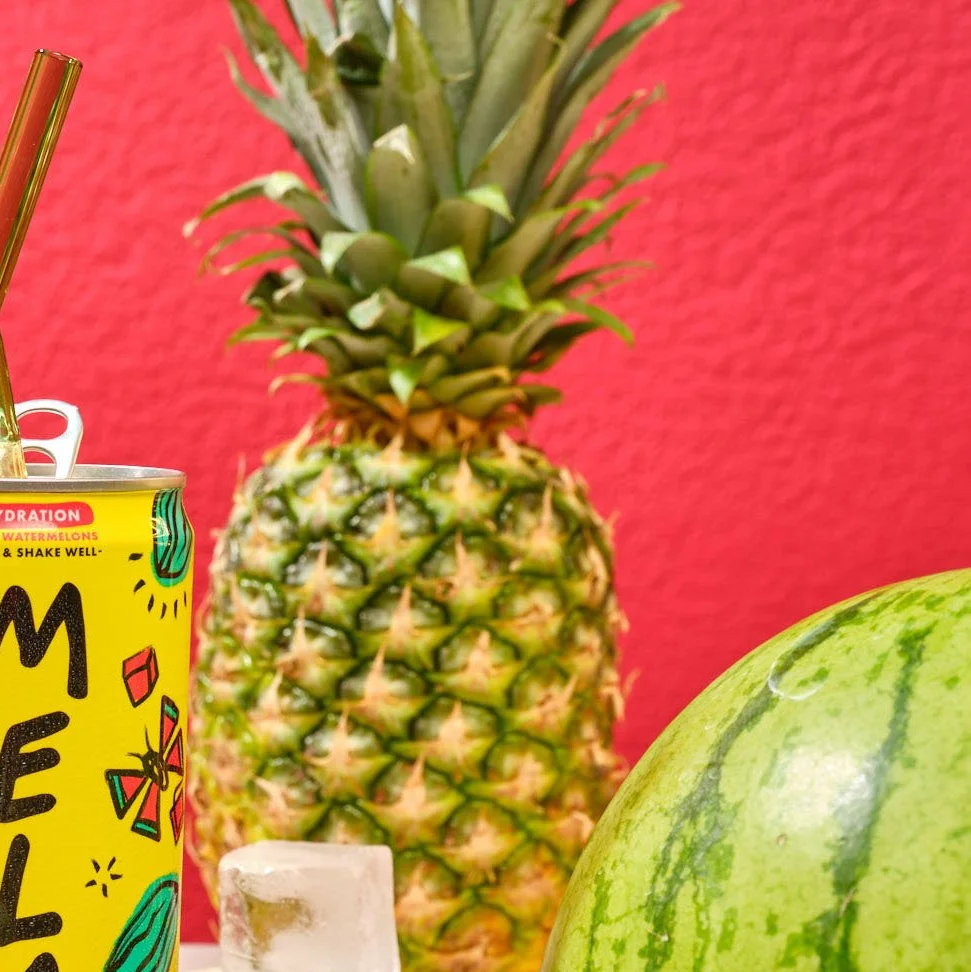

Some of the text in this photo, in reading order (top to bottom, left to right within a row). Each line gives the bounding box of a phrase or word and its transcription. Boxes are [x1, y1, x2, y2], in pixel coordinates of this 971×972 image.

[1, 531, 99, 542] WATERMELONS
[2, 547, 12, 558] &
[16, 547, 61, 558] SHAKE
